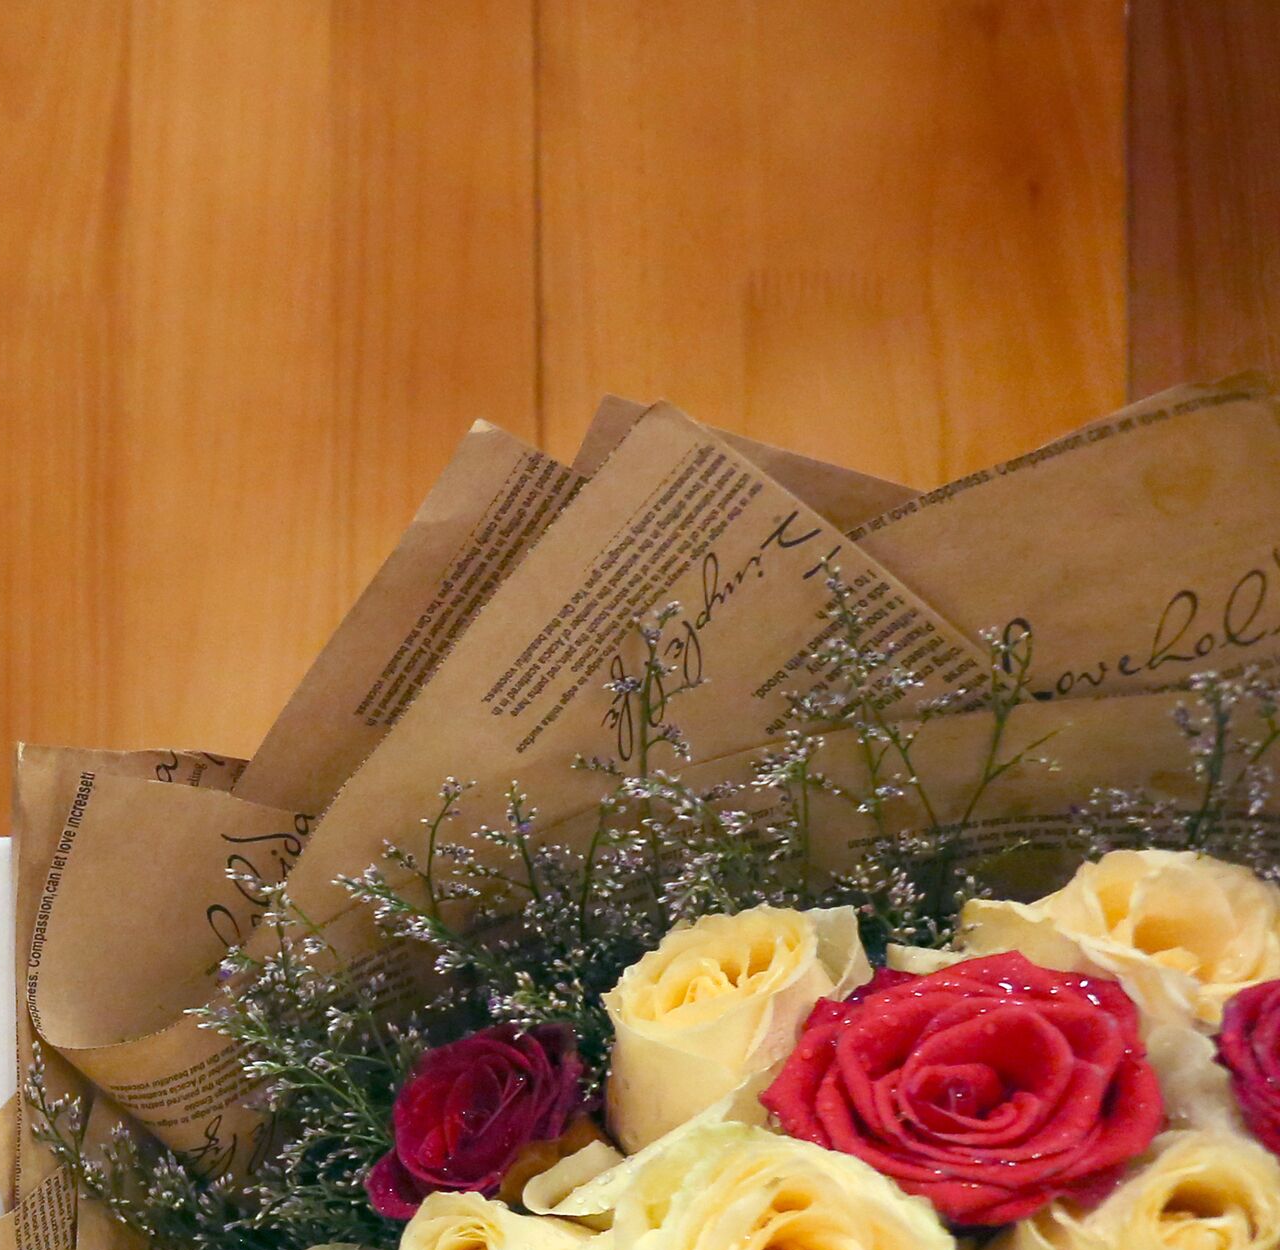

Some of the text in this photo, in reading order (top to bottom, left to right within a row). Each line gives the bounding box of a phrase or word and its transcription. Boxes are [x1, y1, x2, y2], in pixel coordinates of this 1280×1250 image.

[625, 571, 642, 588] the
[593, 583, 611, 601] the
[615, 606, 632, 623] the
[542, 617, 562, 637] that
[559, 626, 573, 641] of
[592, 617, 620, 647] things
[572, 631, 589, 648] the
[513, 633, 548, 670] beautiful
[783, 647, 811, 674] with
[575, 674, 589, 688] to
[556, 682, 580, 707] edge
[55, 828, 76, 855] love
[50, 854, 68, 871] let
